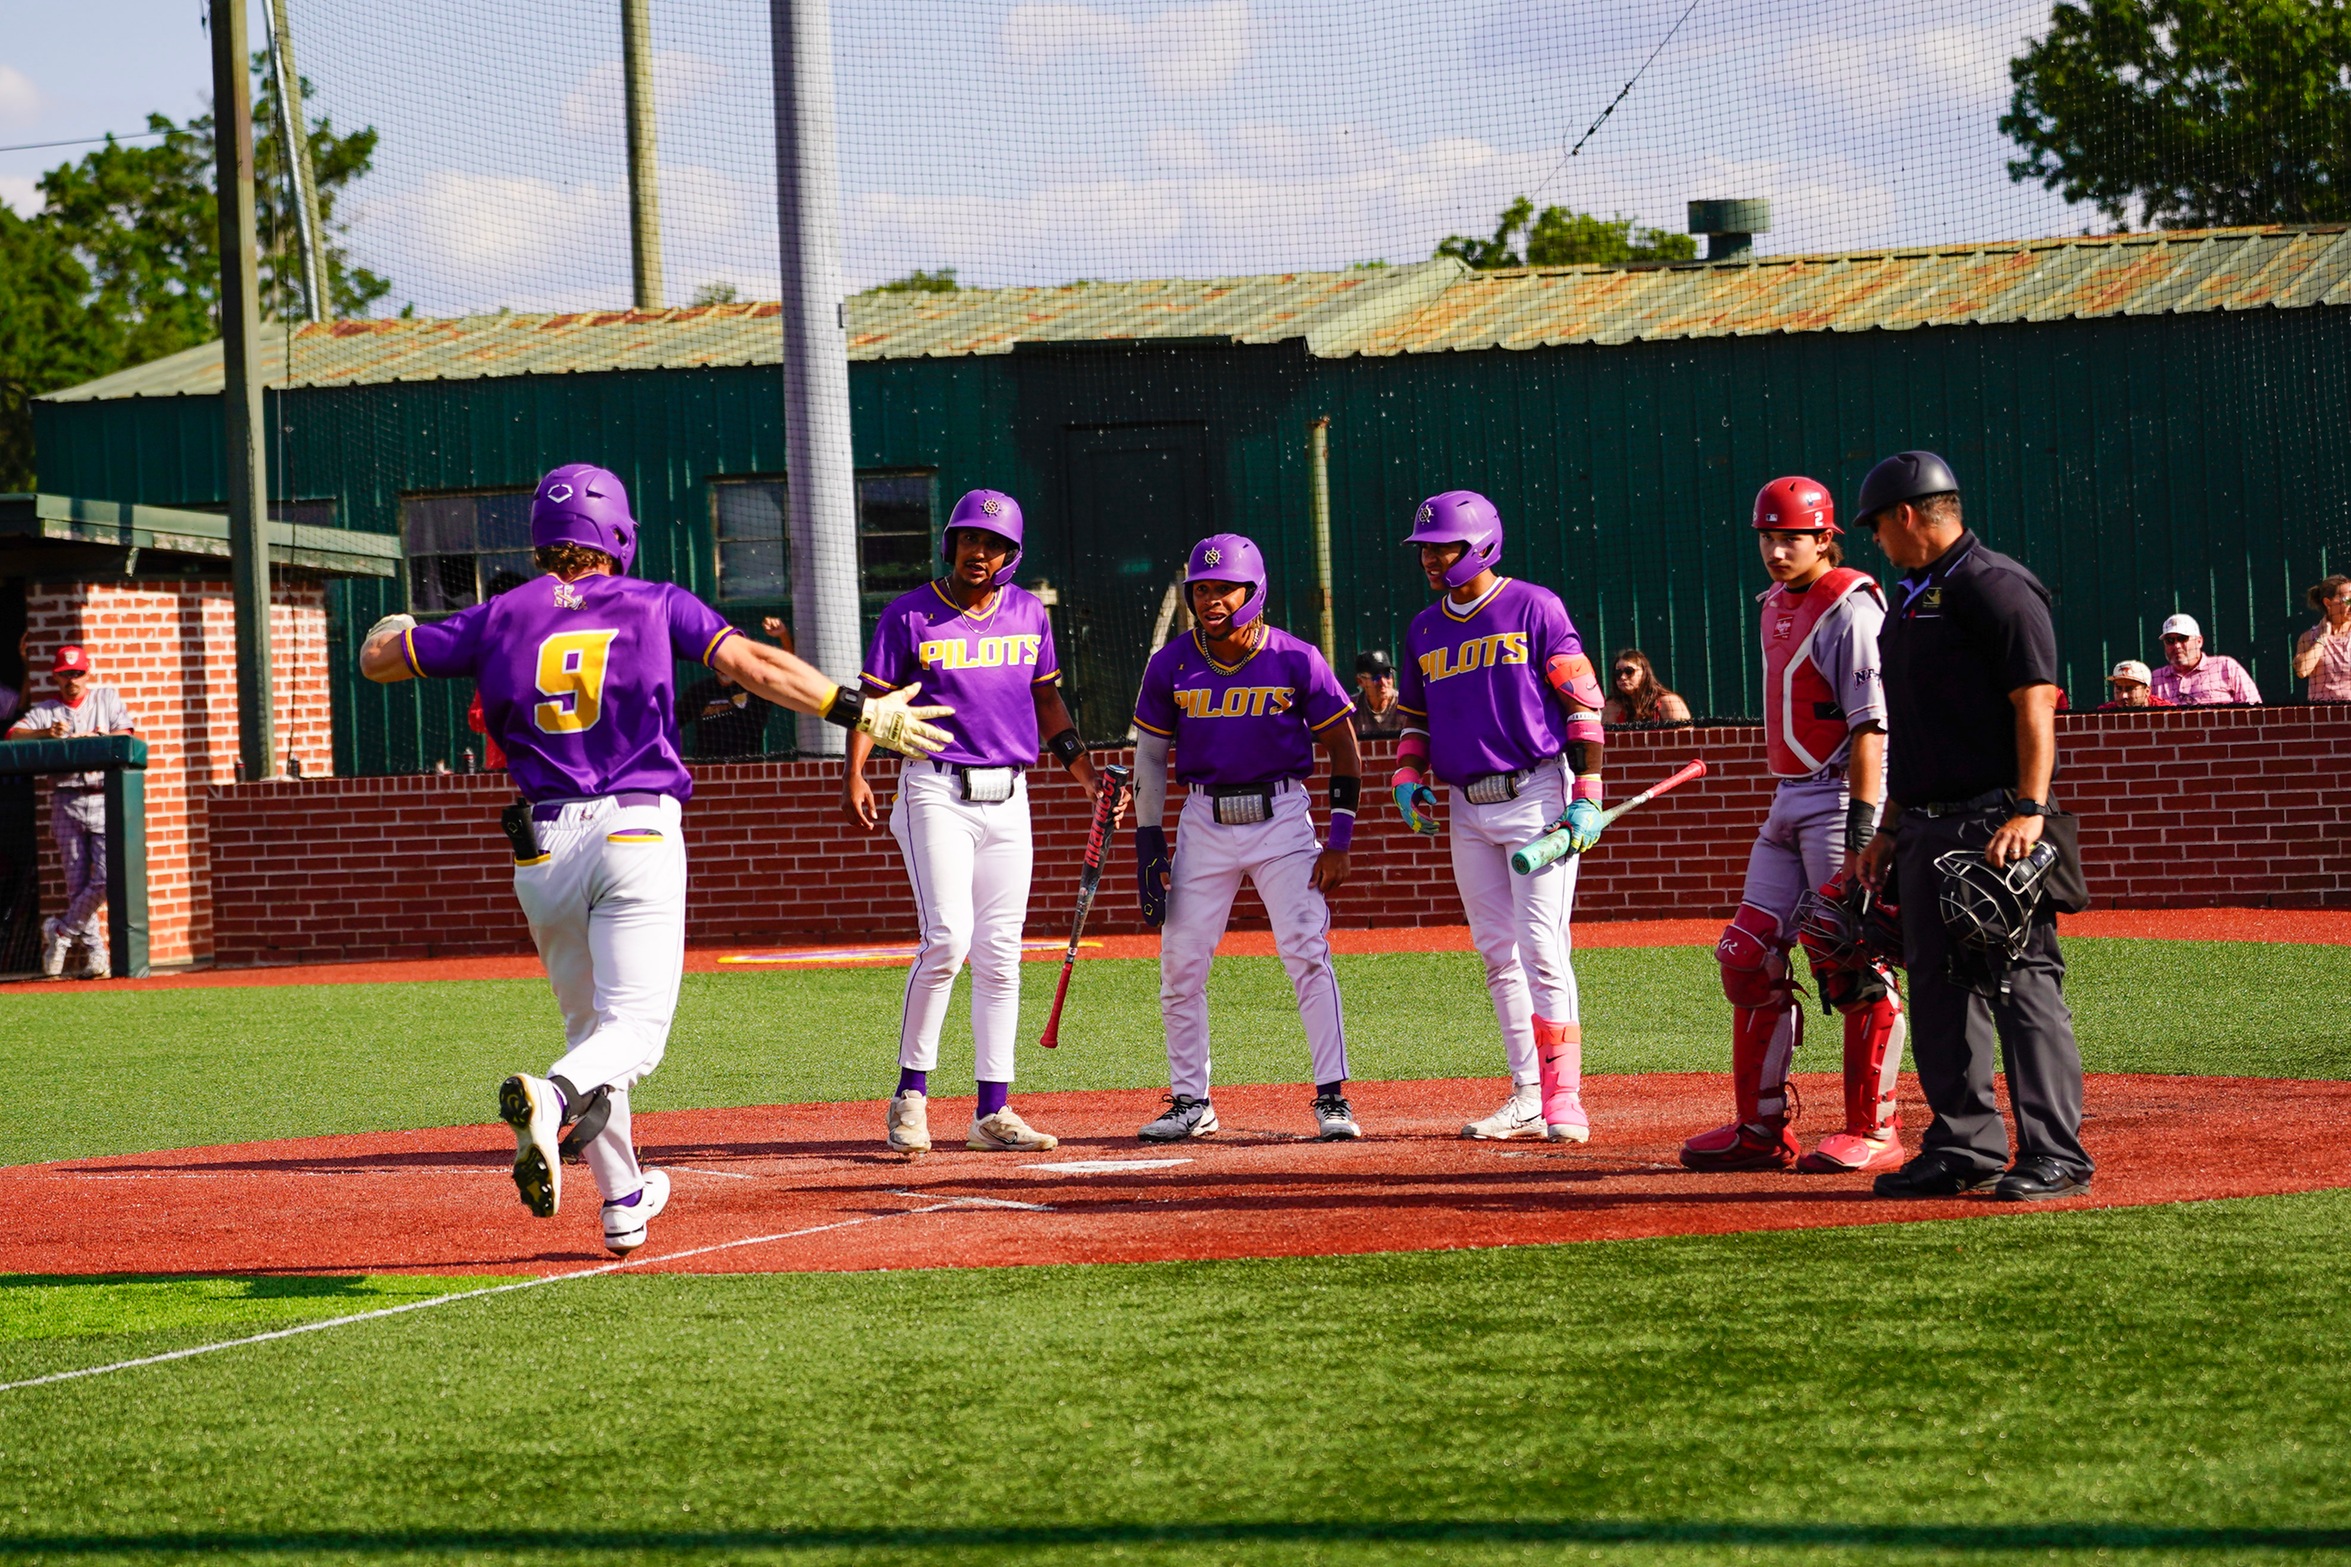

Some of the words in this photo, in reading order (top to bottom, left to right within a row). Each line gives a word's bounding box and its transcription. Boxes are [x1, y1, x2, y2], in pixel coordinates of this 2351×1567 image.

[1814, 511, 1824, 527] 2
[919, 634, 1042, 670] PILOTS
[534, 628, 620, 734] 9
